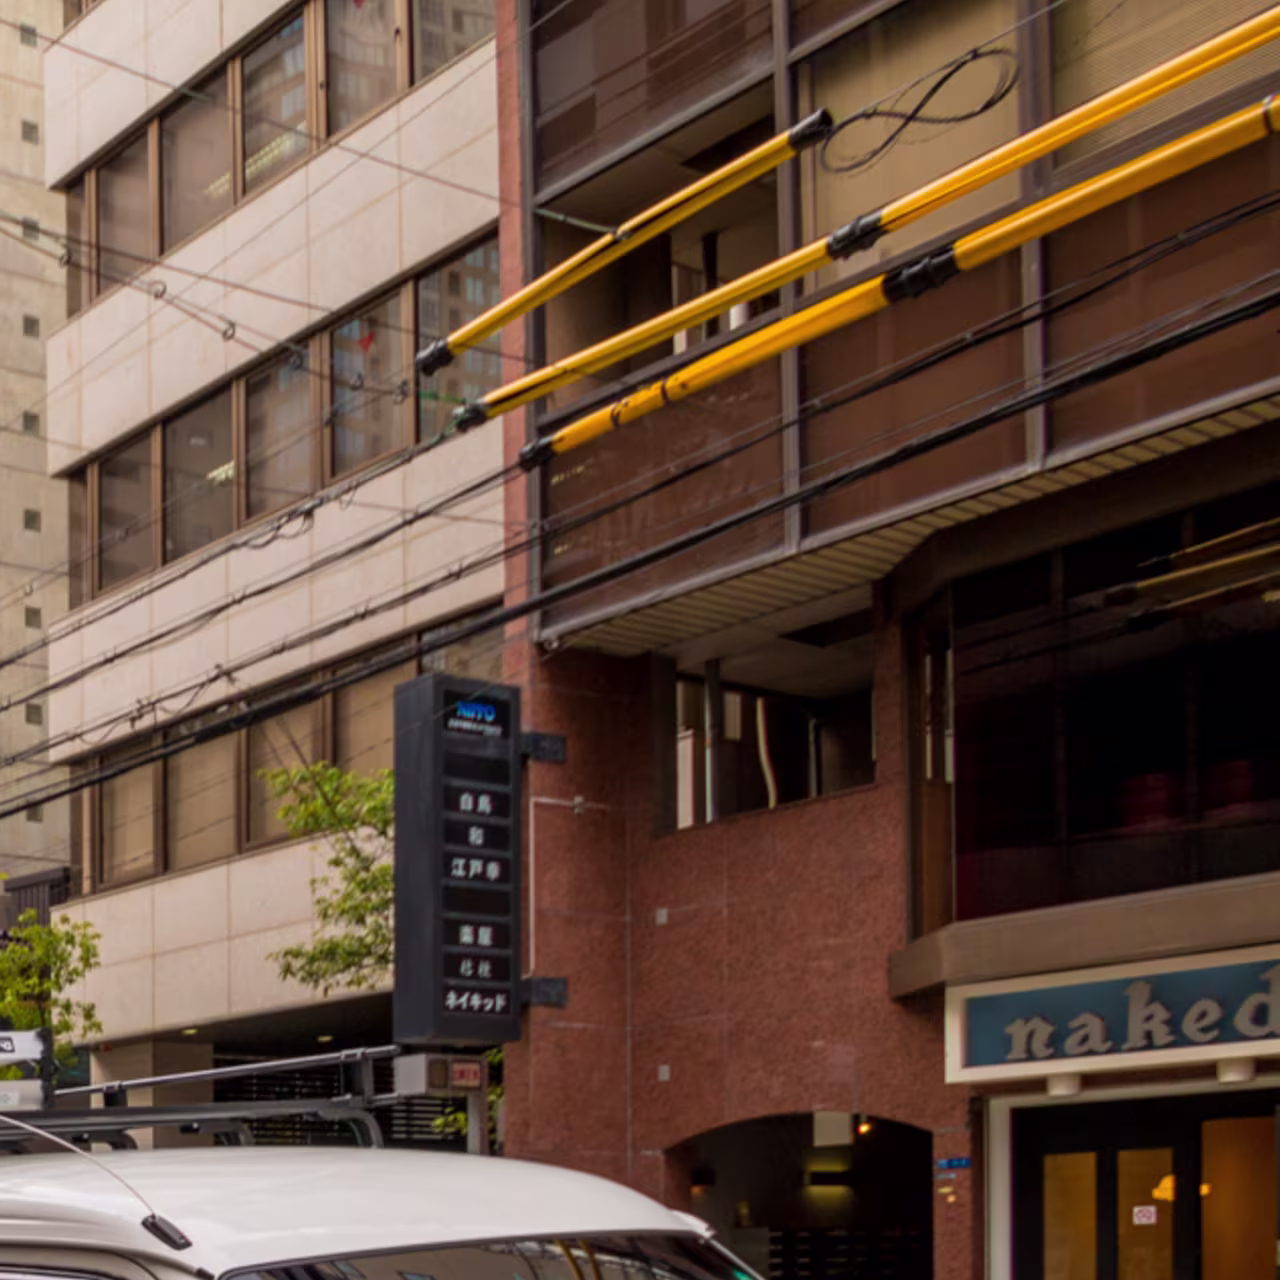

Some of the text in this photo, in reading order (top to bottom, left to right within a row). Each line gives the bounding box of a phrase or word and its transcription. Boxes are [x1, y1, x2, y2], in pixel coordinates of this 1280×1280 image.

[445, 989, 507, 1013] ネイキッド
